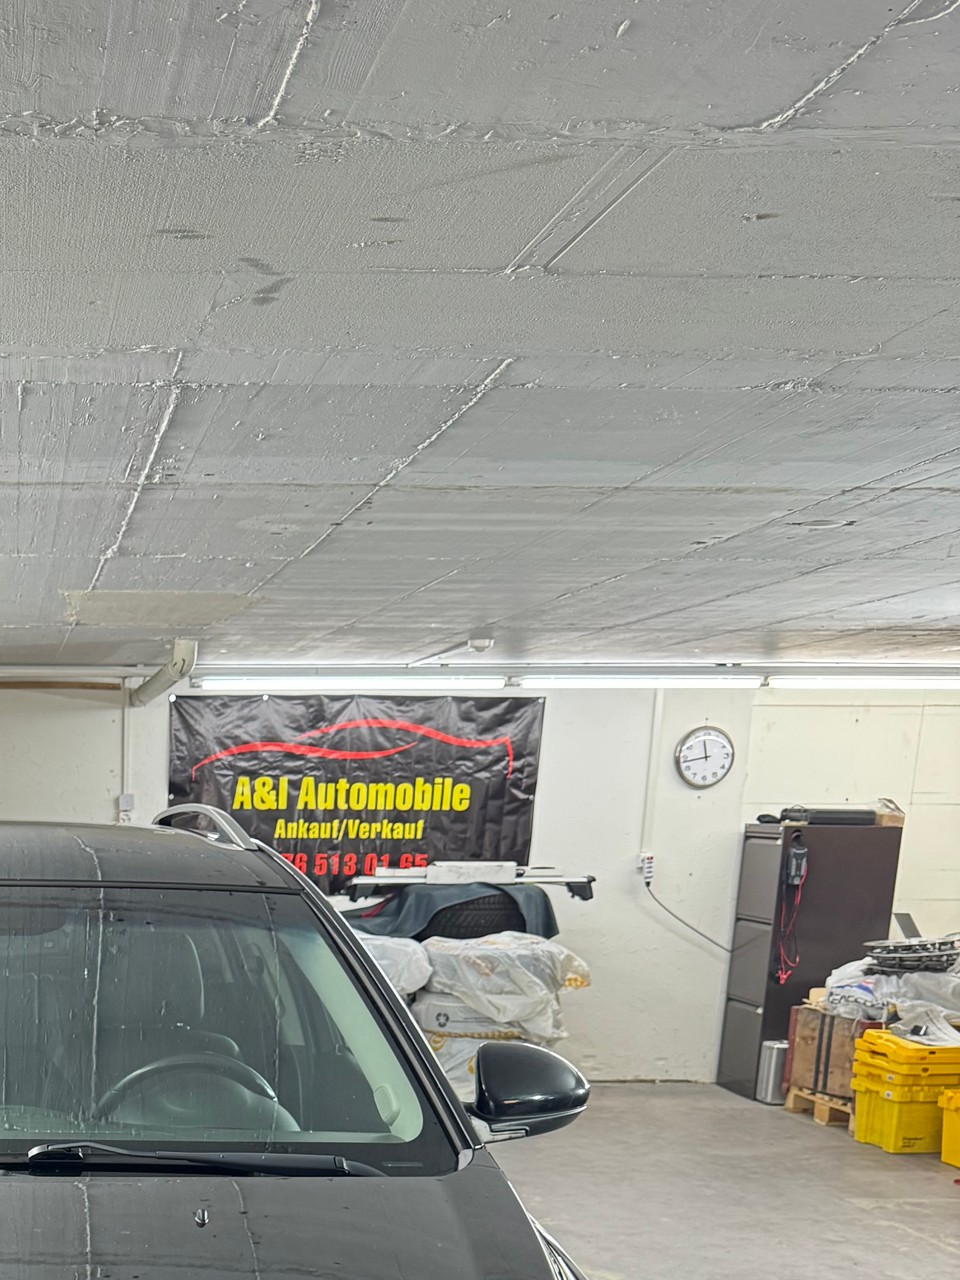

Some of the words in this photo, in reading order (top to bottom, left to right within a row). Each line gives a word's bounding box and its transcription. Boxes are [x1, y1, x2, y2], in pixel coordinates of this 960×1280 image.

[232, 775, 290, 811] A&I
[299, 776, 471, 812] Automobile
[274, 818, 425, 841] Ankauf/Verkauf
[314, 852, 358, 877] 513
